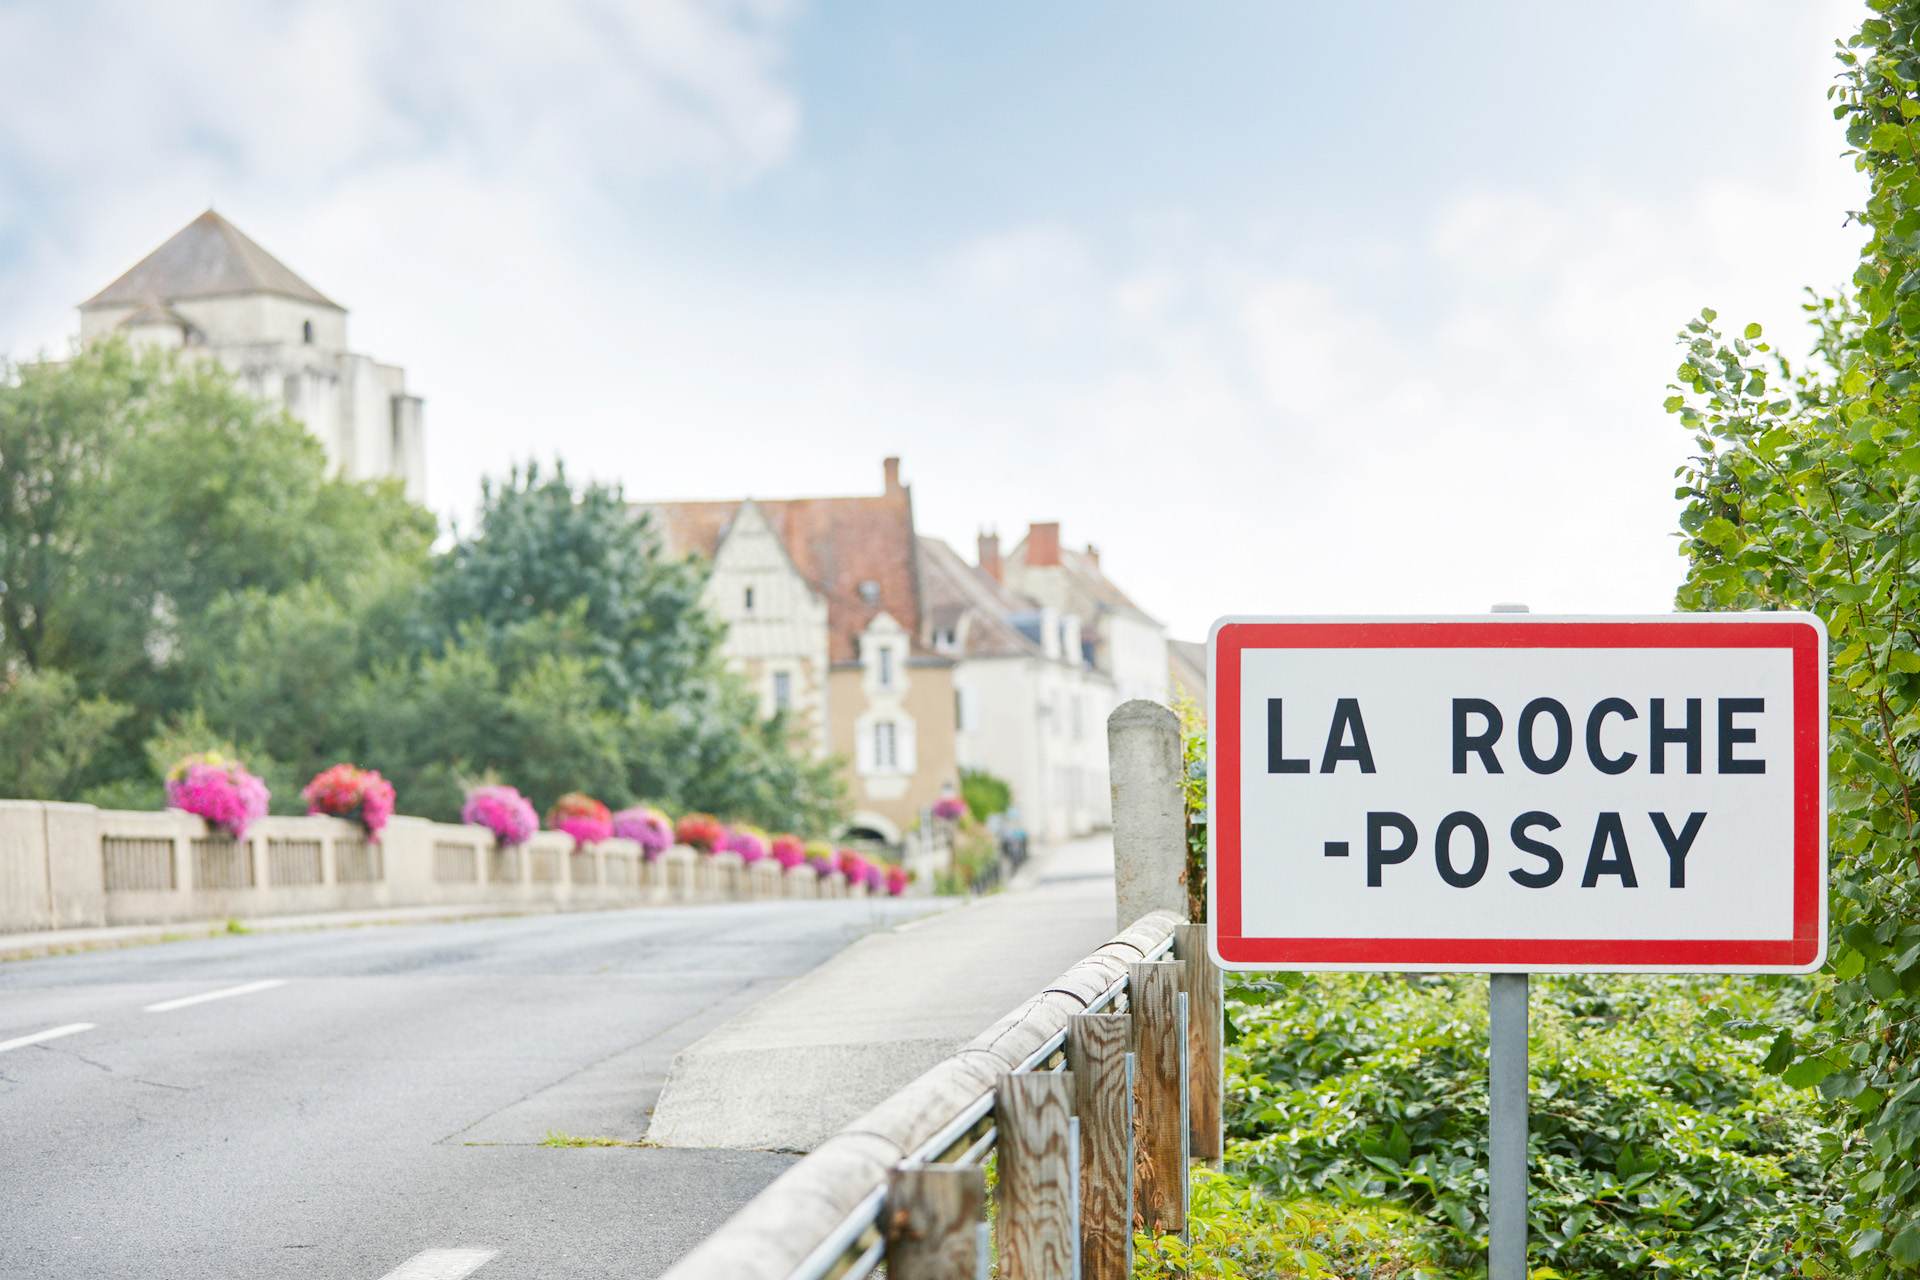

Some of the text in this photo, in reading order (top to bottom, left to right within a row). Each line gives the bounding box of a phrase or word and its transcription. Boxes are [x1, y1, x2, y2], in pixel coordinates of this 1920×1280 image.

[1267, 696, 1767, 775] LA ROCHE
[1324, 810, 1708, 889] -POSAY
